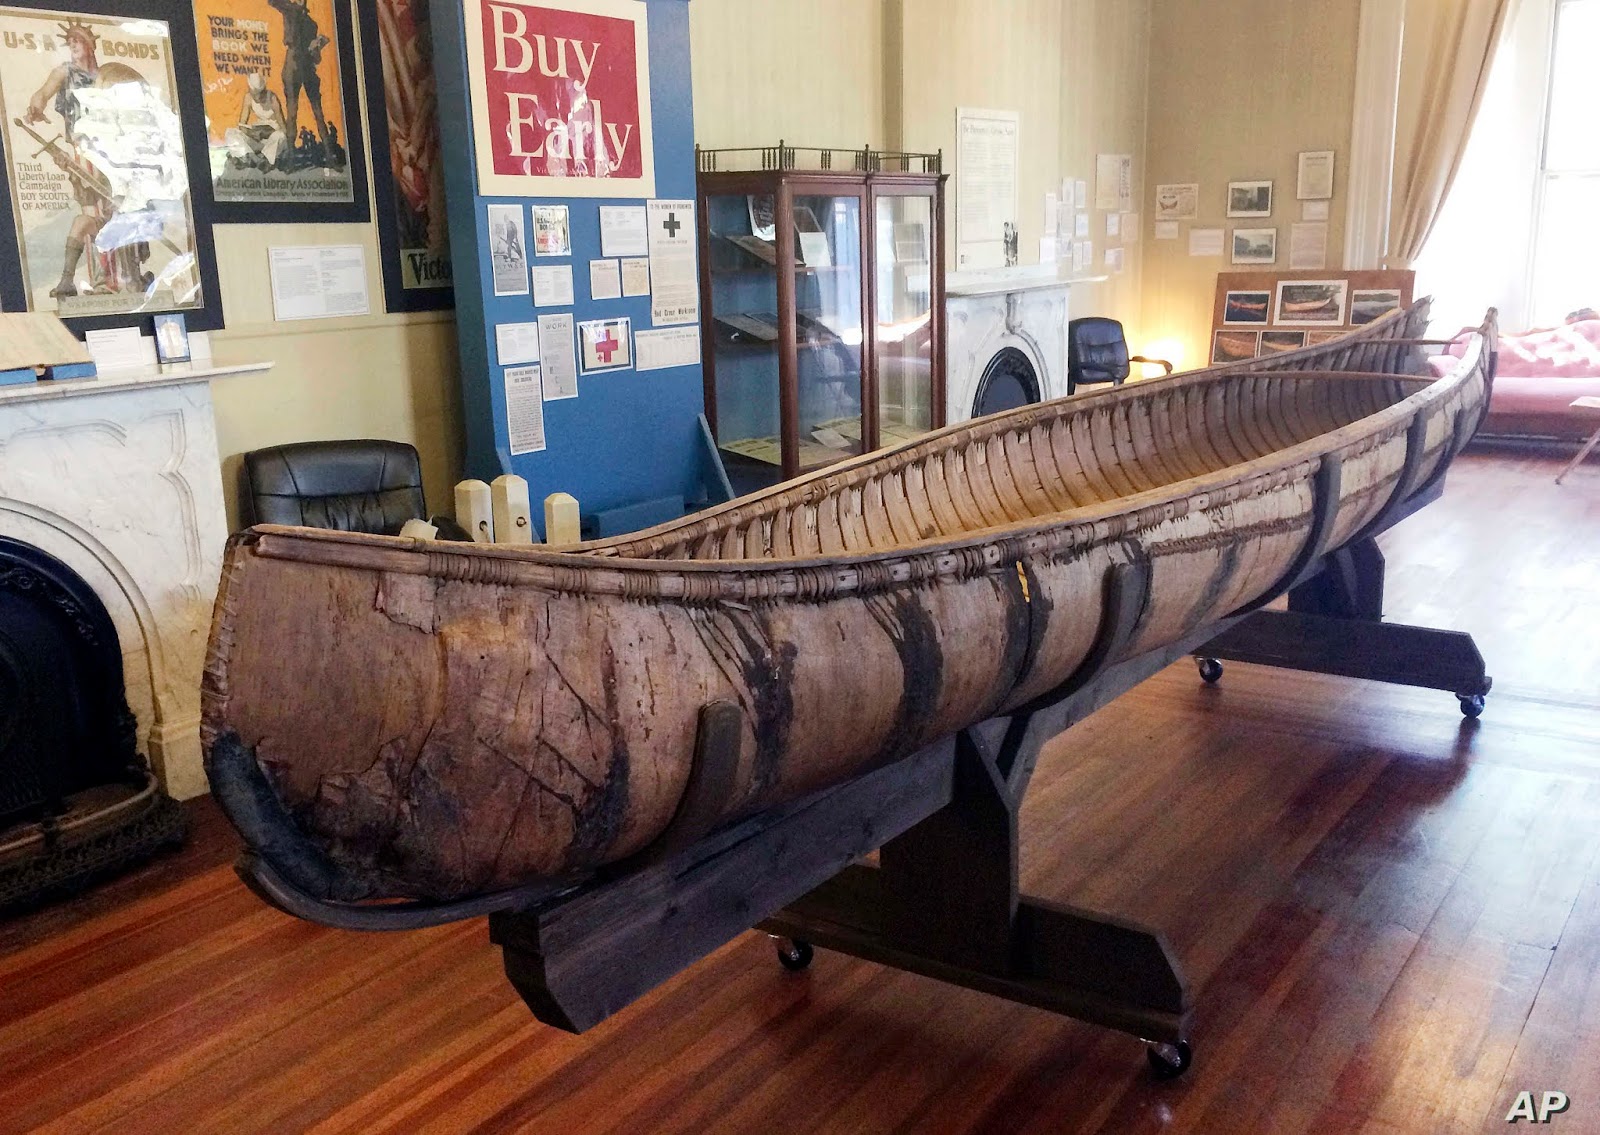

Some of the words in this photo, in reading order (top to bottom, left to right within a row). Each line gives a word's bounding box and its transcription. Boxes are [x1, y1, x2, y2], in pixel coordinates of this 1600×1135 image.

[207, 14, 234, 27] YOUR
[211, 27, 248, 40] BRINGS
[252, 31, 269, 42] THE
[101, 39, 160, 60] BONDS
[212, 39, 247, 52] BOOK
[250, 43, 269, 53] WE
[488, 4, 600, 91] Buy
[213, 52, 239, 63] NEED
[241, 54, 271, 66] WHEN
[215, 63, 230, 74] WE
[232, 65, 259, 75] WANT
[262, 67, 271, 77] IT
[504, 92, 632, 171] Early
[16, 162, 42, 172] Third
[18, 172, 45, 182] Liberty
[46, 172, 66, 181] Loan
[216, 177, 261, 189] American
[264, 178, 296, 191] Library
[297, 177, 349, 189] Association
[19, 181, 62, 192] Campaign
[20, 193, 36, 201] BOY
[39, 193, 70, 201] SCOUTS
[22, 202, 33, 210] OF
[35, 202, 71, 210] AMERICA
